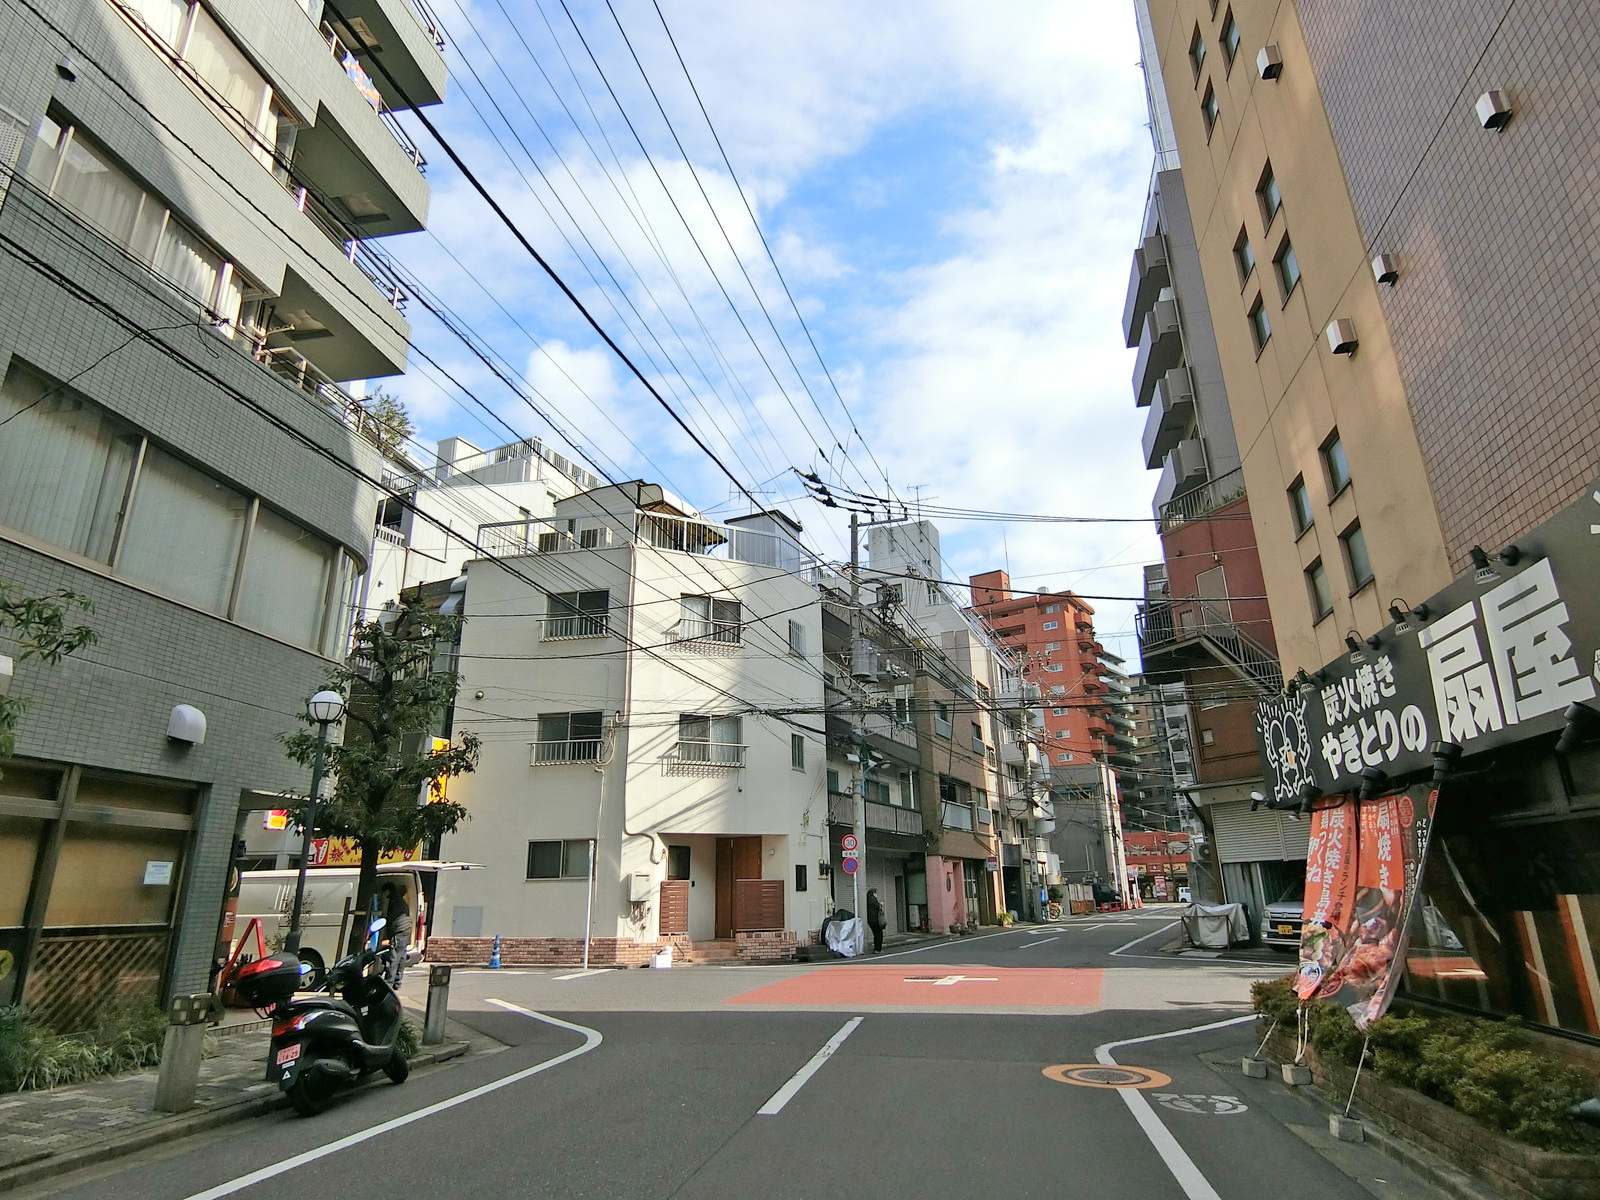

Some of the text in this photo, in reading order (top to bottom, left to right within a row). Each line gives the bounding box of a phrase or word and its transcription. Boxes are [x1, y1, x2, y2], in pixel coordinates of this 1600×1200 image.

[1417, 557, 1596, 743] 扇屋
[1320, 655, 1396, 726] 炭火焼き
[1321, 704, 1427, 780] やきとりの
[846, 838, 854, 847] 30
